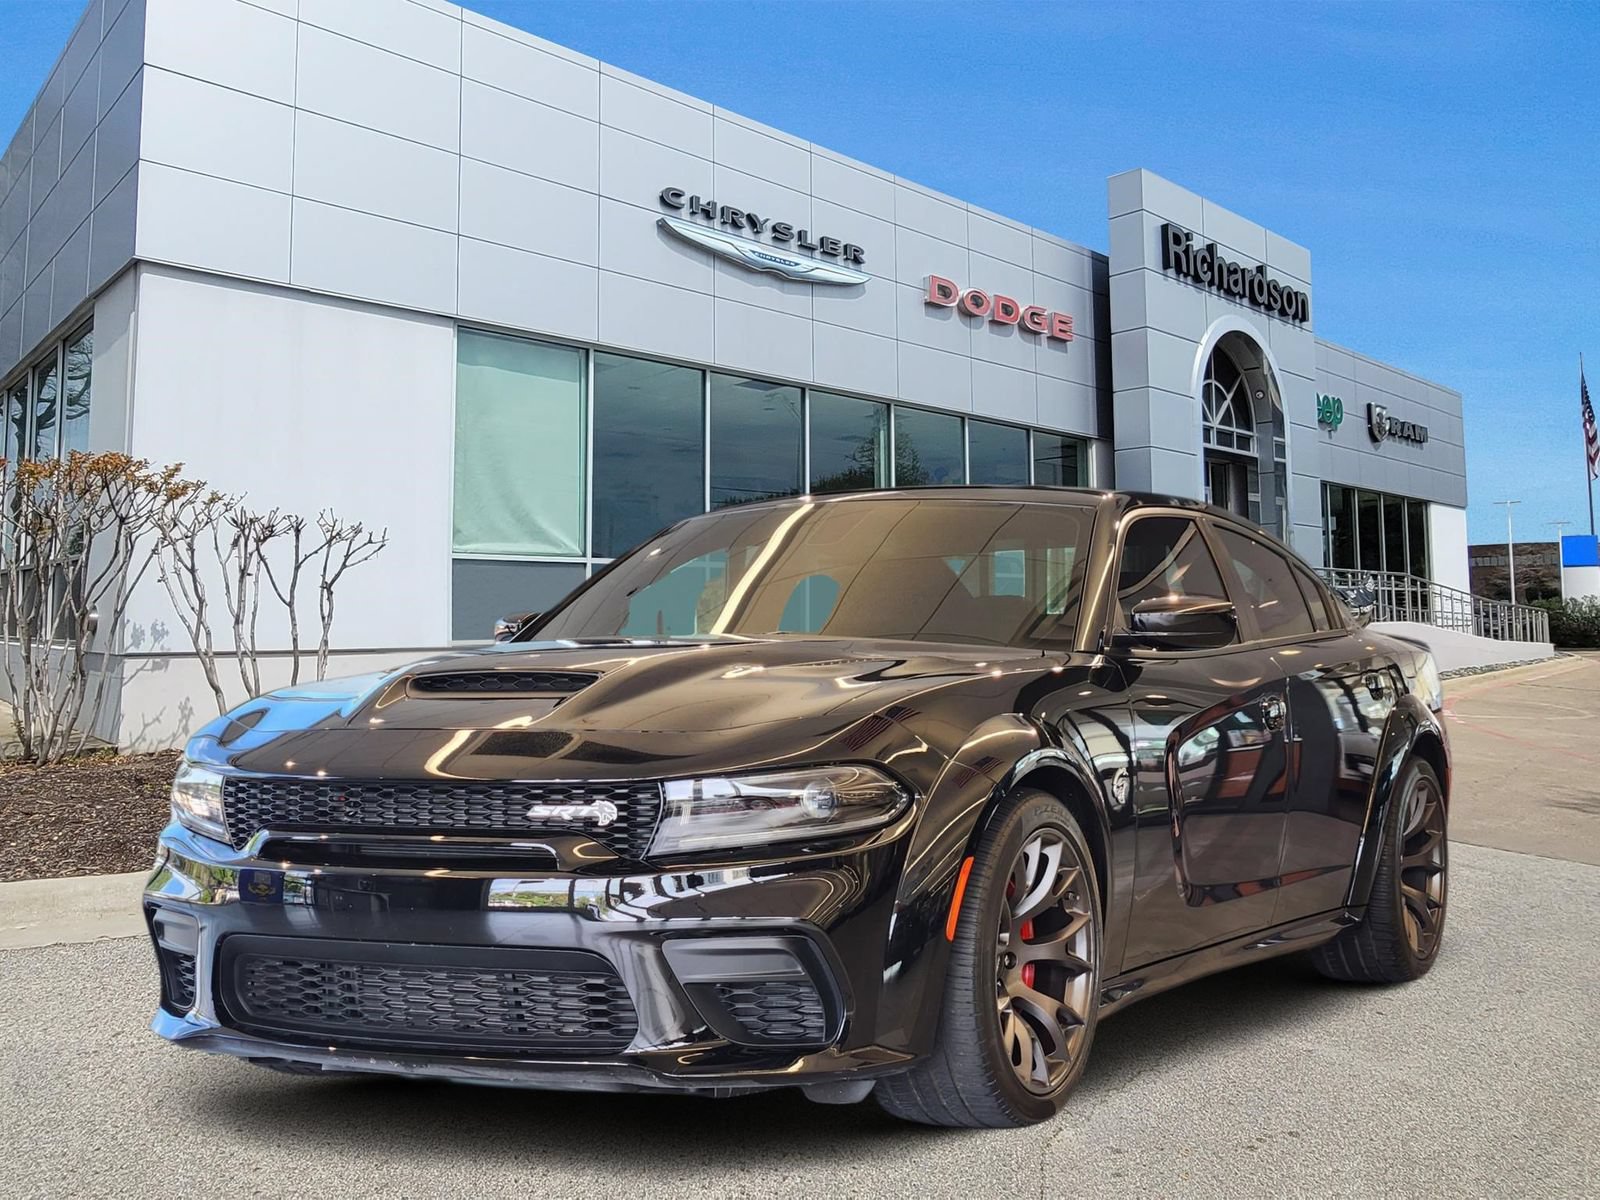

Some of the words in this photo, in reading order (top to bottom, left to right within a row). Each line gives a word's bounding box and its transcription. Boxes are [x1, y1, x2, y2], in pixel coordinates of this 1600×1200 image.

[659, 187, 865, 264] CHRYSLER
[1161, 223, 1309, 323] Richardson
[923, 275, 1073, 342] DODGE
[1385, 416, 1428, 443] RAM
[526, 804, 600, 821] SRT
